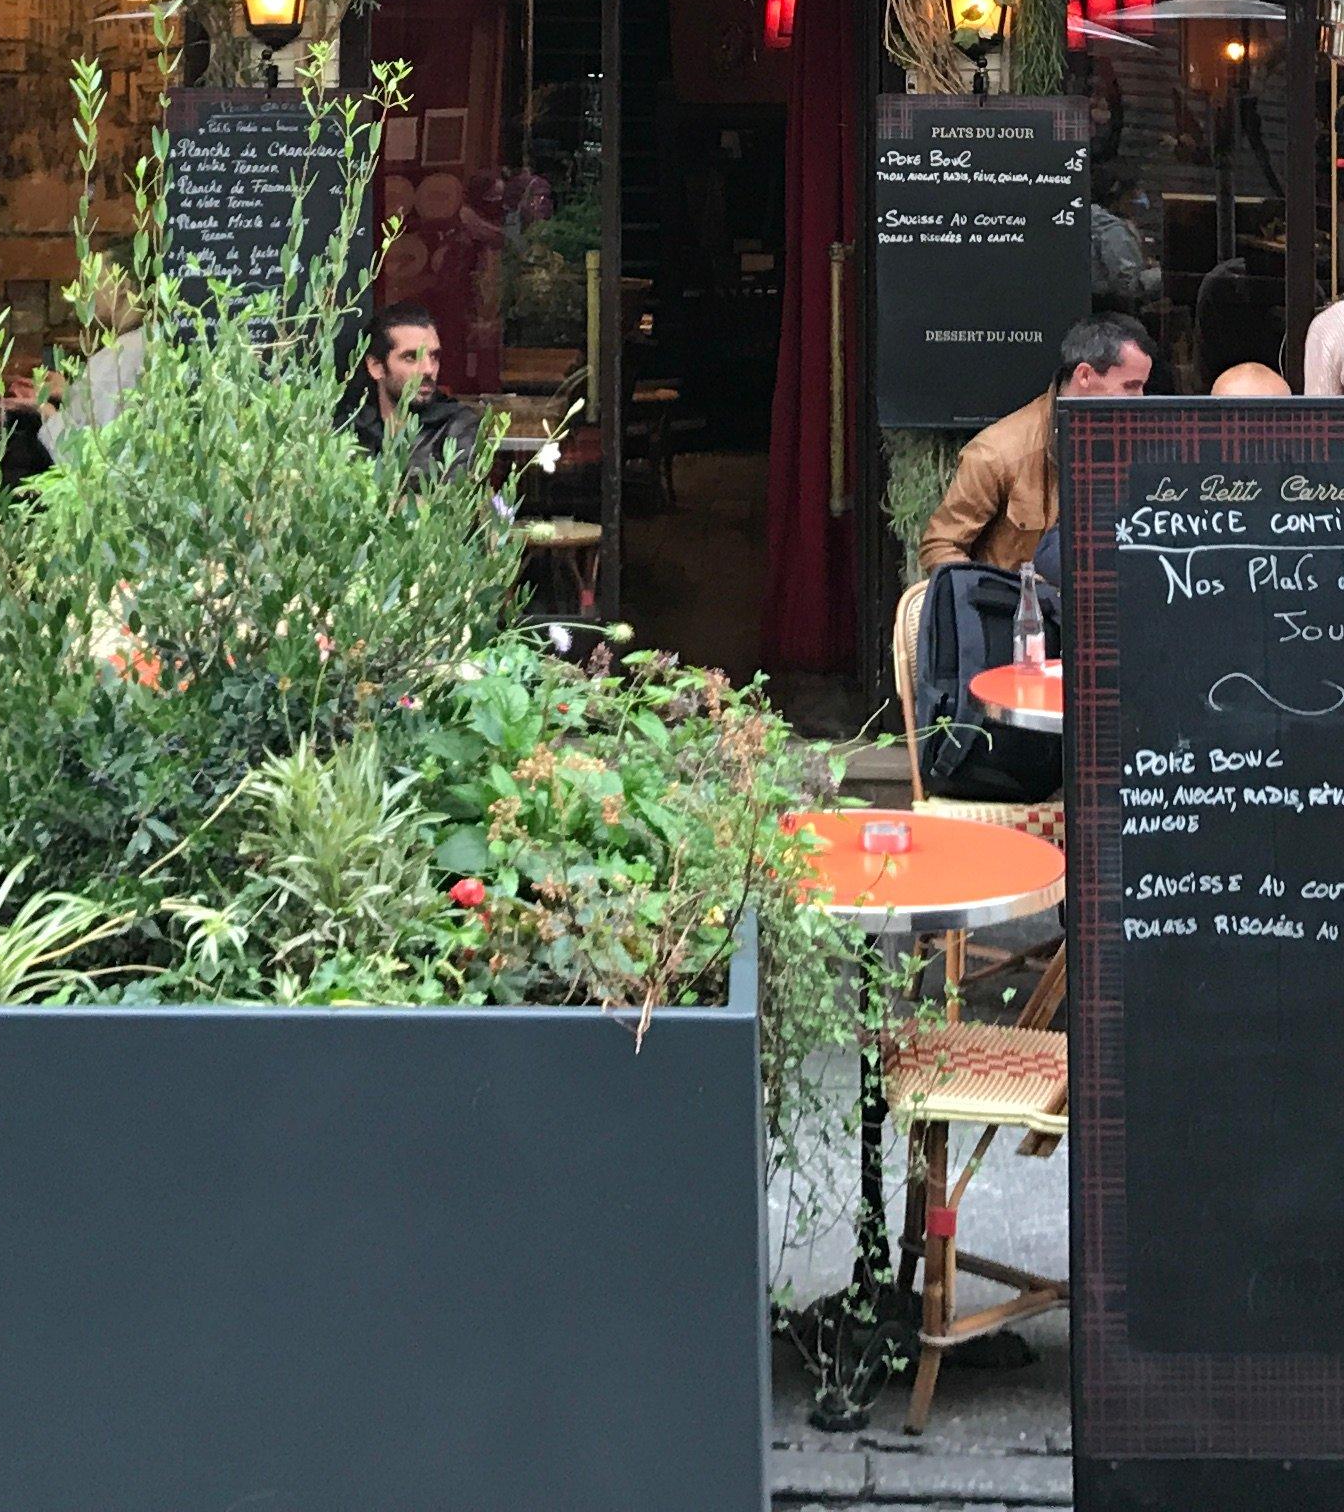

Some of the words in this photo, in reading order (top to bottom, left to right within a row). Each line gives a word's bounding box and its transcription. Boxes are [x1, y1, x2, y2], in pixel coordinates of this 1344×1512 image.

[931, 127, 974, 138] PLATS
[976, 127, 996, 138] DU
[997, 127, 1034, 139] JOUR
[950, 213, 968, 226] AU
[974, 213, 1026, 226] COUTEAU
[925, 330, 985, 342] DESSERT
[987, 331, 1006, 342] DU
[1008, 331, 1043, 343] JOUR
[1146, 477, 1188, 502] Les
[1200, 474, 1262, 502] Petits
[1159, 549, 1225, 604] Nos
[1248, 553, 1319, 594] Plats
[1122, 814, 1200, 835] MANGUE
[1258, 874, 1285, 898] AU
[1316, 920, 1339, 941] AU
